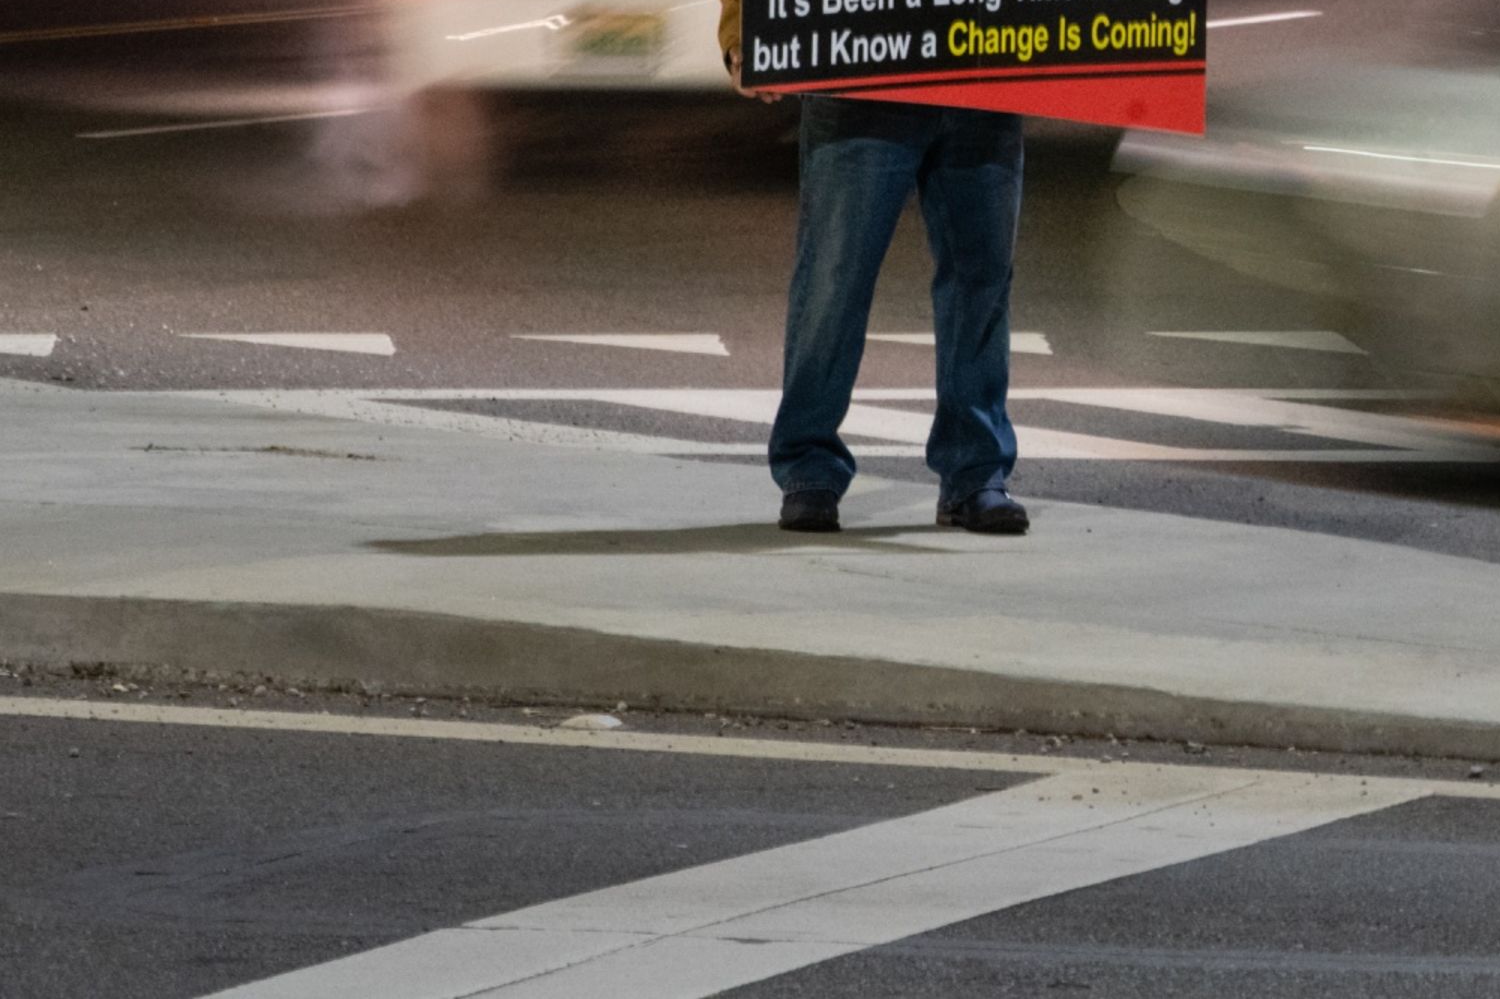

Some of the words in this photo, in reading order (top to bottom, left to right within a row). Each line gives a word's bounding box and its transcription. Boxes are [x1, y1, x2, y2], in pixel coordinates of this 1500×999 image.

[753, 37, 801, 72] but
[811, 34, 818, 66] I
[830, 29, 912, 66] Know
[921, 33, 937, 59] a
[948, 17, 1049, 61] Change
[1058, 17, 1081, 51] Is
[1091, 11, 1197, 55] Coming!
